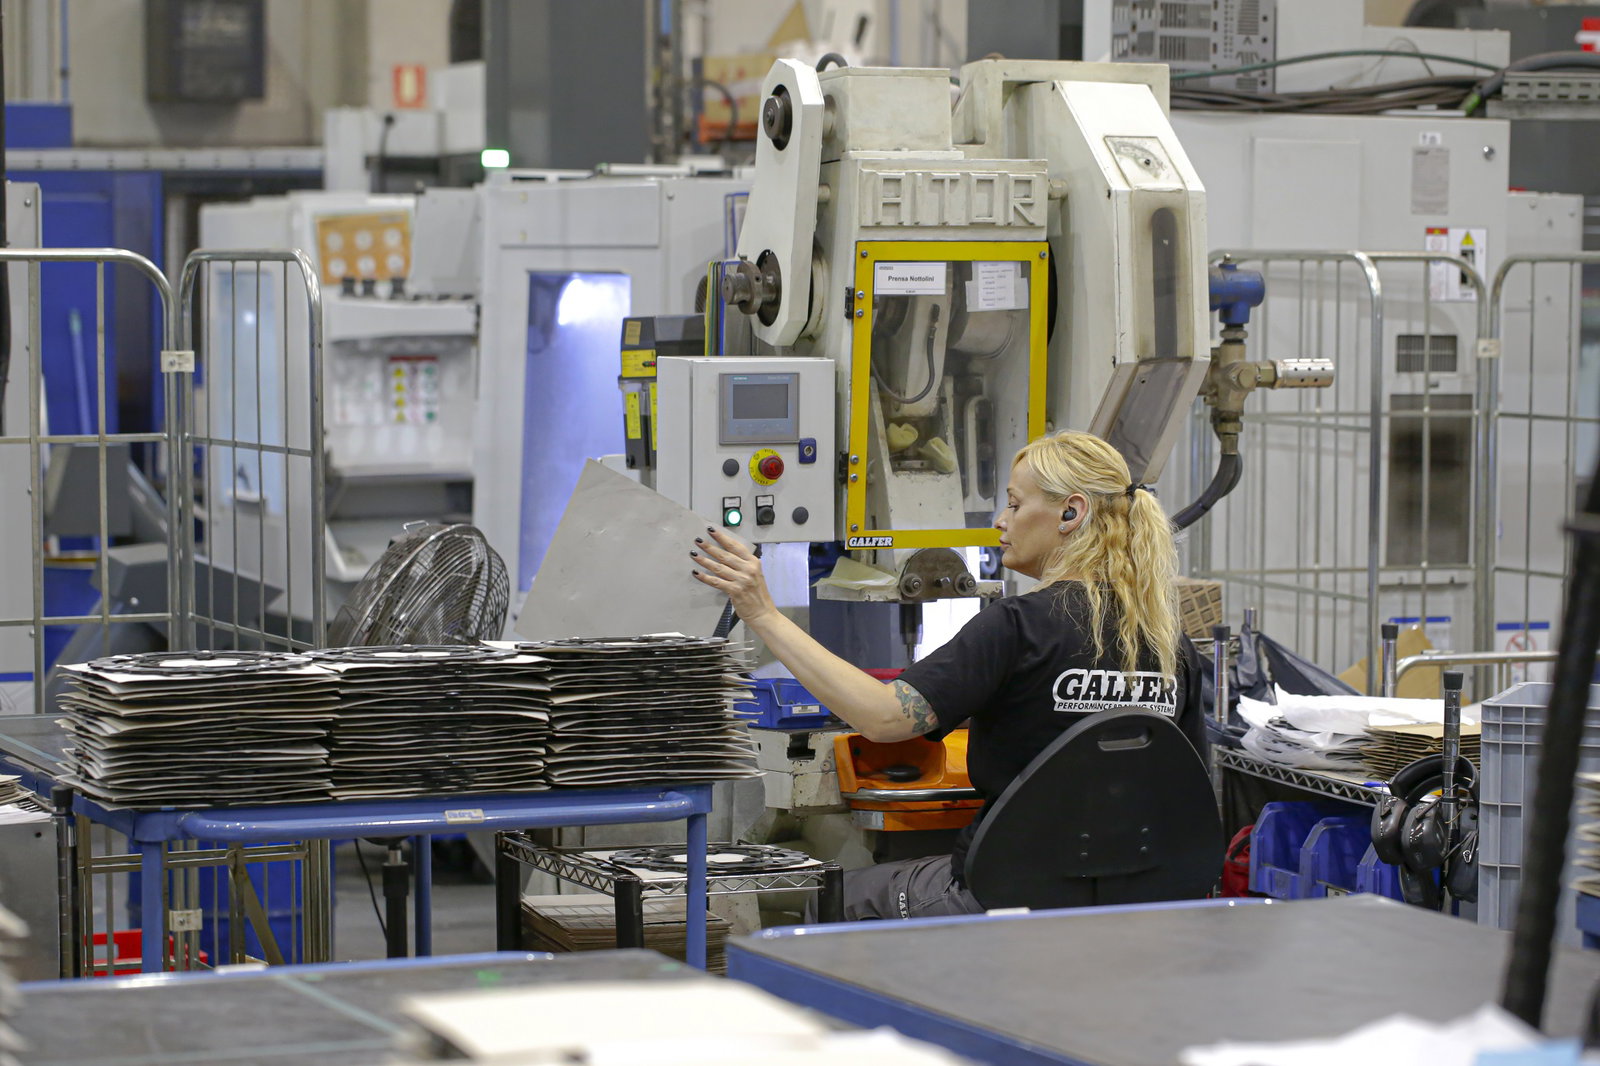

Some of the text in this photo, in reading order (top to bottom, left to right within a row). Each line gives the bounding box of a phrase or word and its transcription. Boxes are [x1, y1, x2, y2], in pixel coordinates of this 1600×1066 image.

[875, 172, 1036, 226] AITOR
[848, 536, 893, 547] GALFER
[1055, 670, 1176, 706] GALFER
